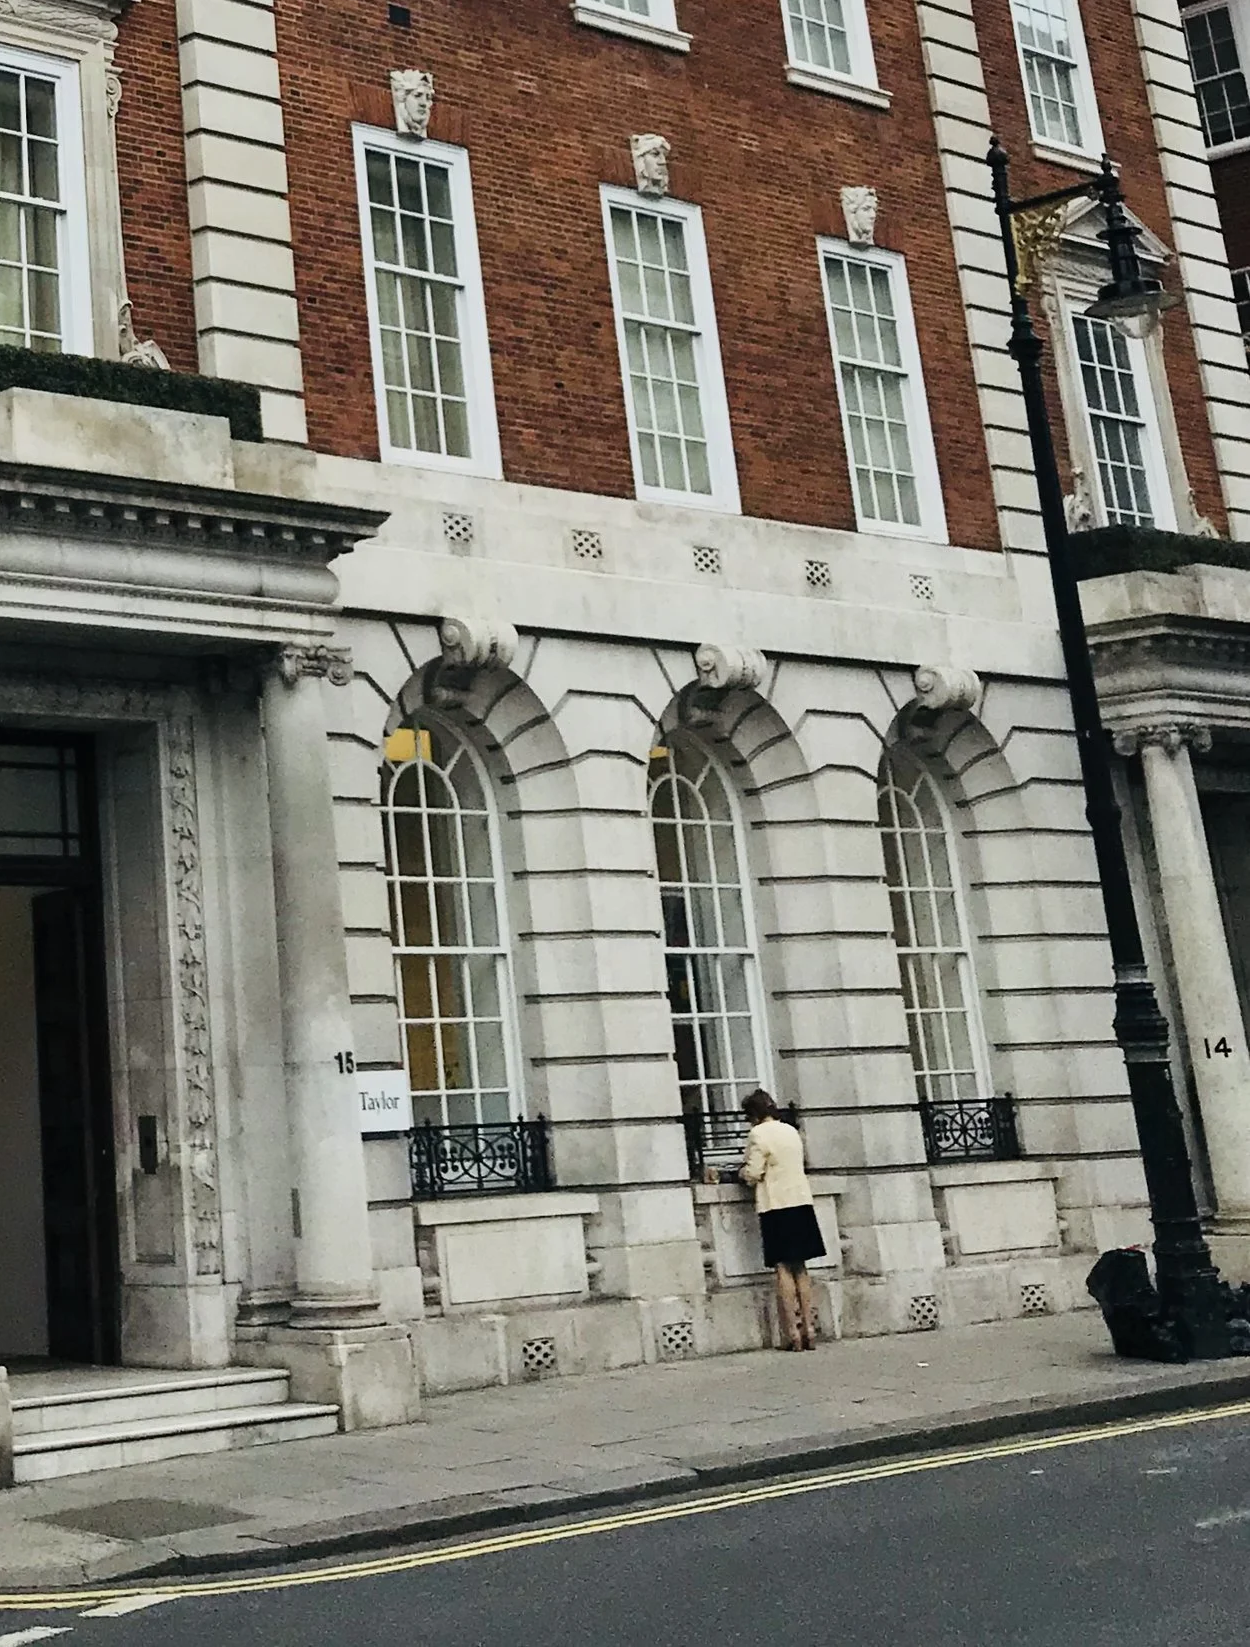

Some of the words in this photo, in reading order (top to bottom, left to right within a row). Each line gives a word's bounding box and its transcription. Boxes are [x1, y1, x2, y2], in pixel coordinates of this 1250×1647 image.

[1204, 1036, 1232, 1059] 14
[334, 1051, 355, 1074] 15
[358, 1090, 400, 1117] Taylor
